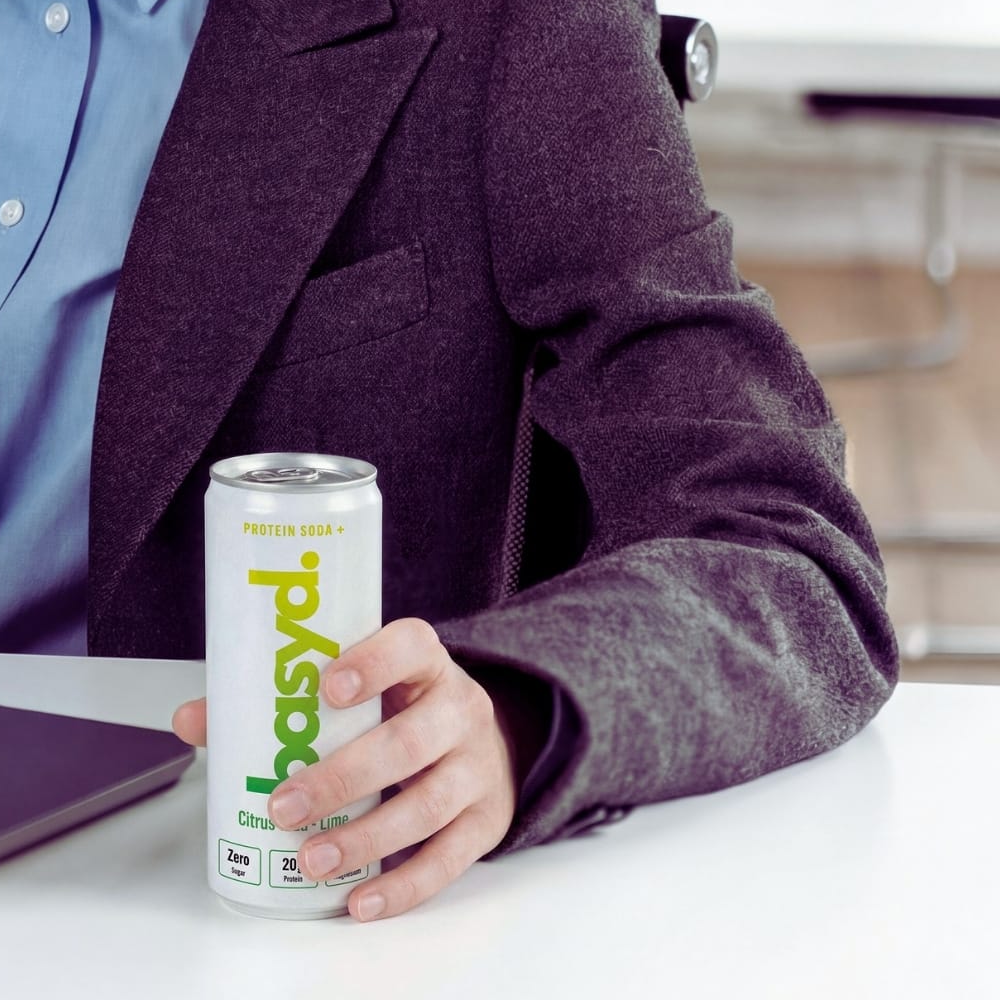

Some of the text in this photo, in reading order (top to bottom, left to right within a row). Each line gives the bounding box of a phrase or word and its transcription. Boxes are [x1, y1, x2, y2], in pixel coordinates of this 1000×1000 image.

[243, 522, 296, 537] PROTEIN
[300, 524, 333, 537] SODA
[238, 810, 275, 831] Citrus
[320, 814, 349, 831] Lime
[227, 848, 250, 866] Zero
[231, 867, 246, 877] Sugar
[283, 875, 304, 883] Protein
